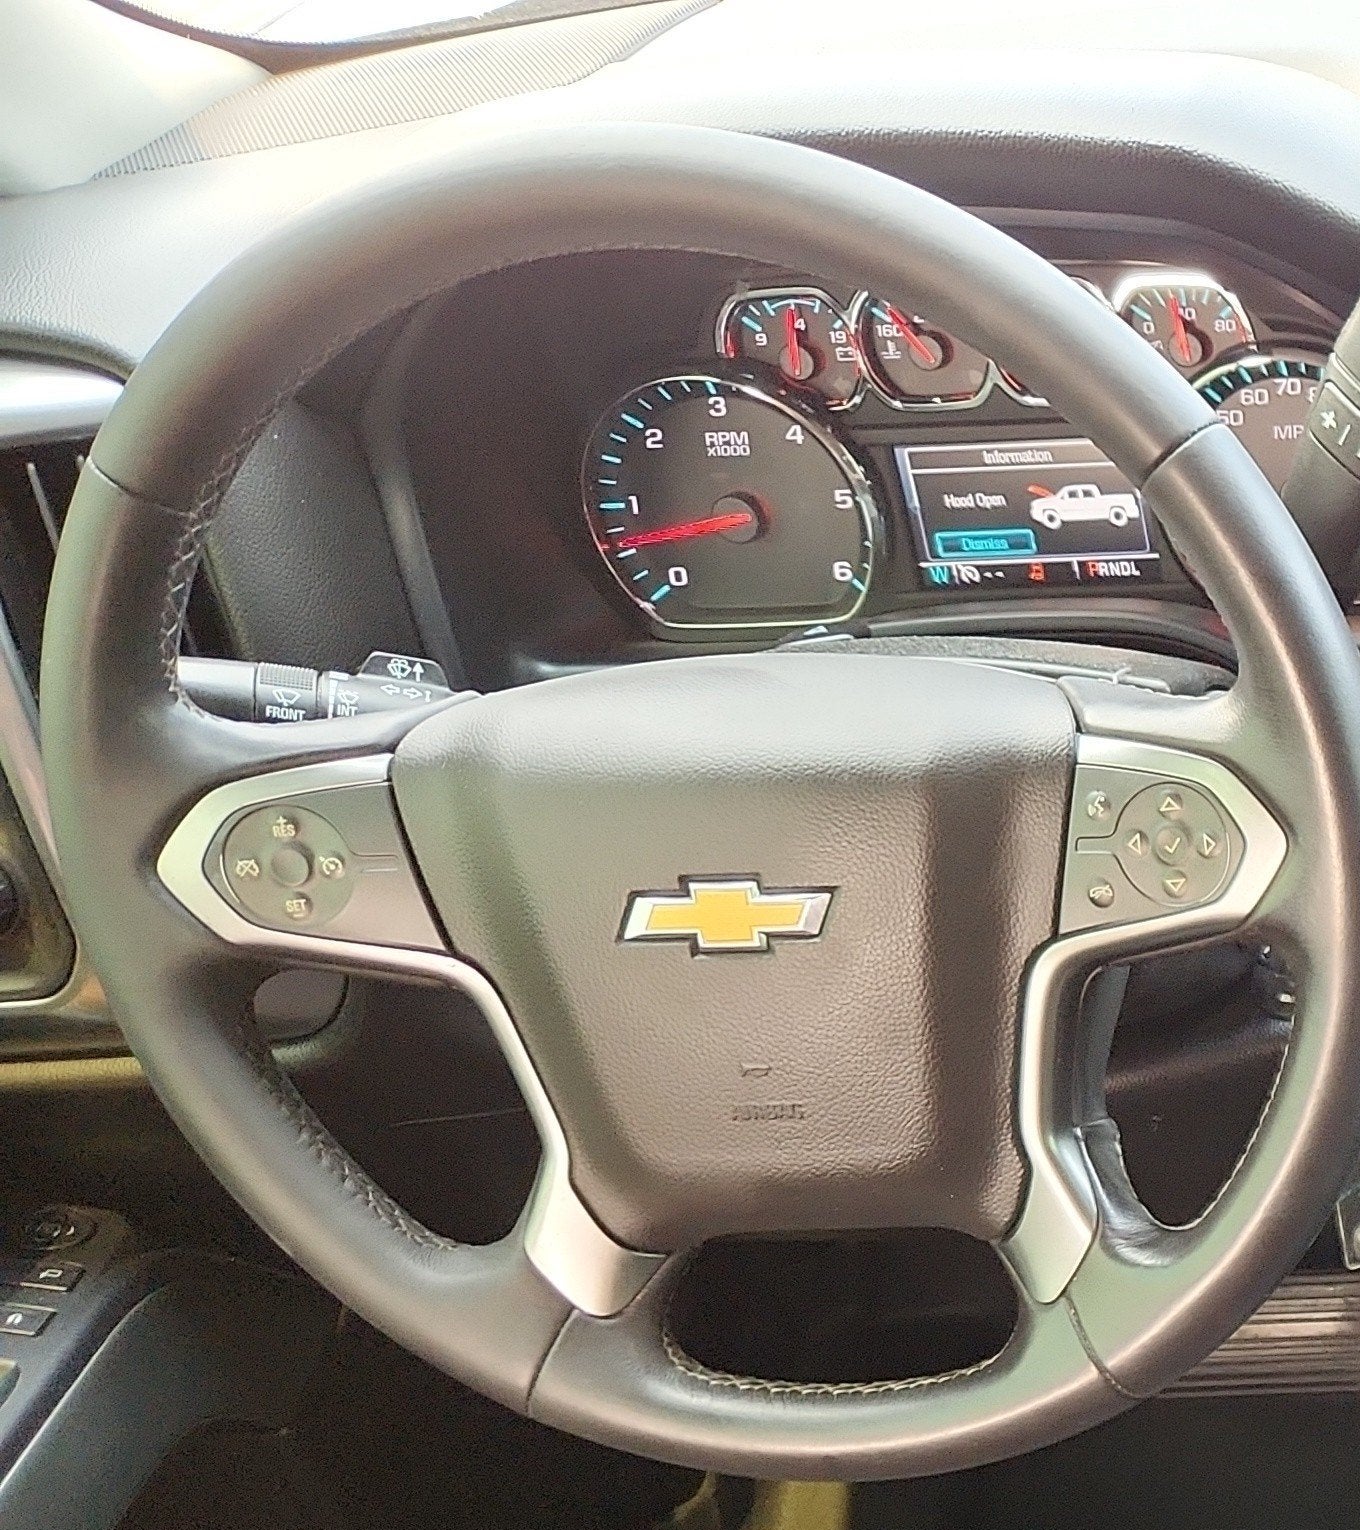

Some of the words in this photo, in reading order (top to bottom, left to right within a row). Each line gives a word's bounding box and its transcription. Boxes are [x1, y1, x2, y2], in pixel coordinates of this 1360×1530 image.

[1214, 319, 1237, 334] 80
[755, 333, 768, 346] 9
[828, 330, 847, 344] 19
[1273, 378, 1301, 397] 70
[1240, 388, 1270, 407] 60
[709, 398, 727, 418] 3
[645, 430, 664, 450] 2
[704, 431, 750, 447] RPM
[785, 424, 805, 444] 4
[1273, 424, 1304, 440] MP
[983, 448, 1053, 464] Information
[628, 495, 640, 515] 1
[834, 490, 853, 510] 5
[943, 493, 973, 509] Hood
[976, 492, 1007, 508] Open
[961, 536, 1009, 552] Dismiss
[668, 566, 689, 587] 0
[832, 561, 853, 582] 6
[265, 704, 306, 721] FRONT
[336, 704, 359, 717] INT
[272, 822, 296, 839] RES
[286, 898, 308, 913] SET
